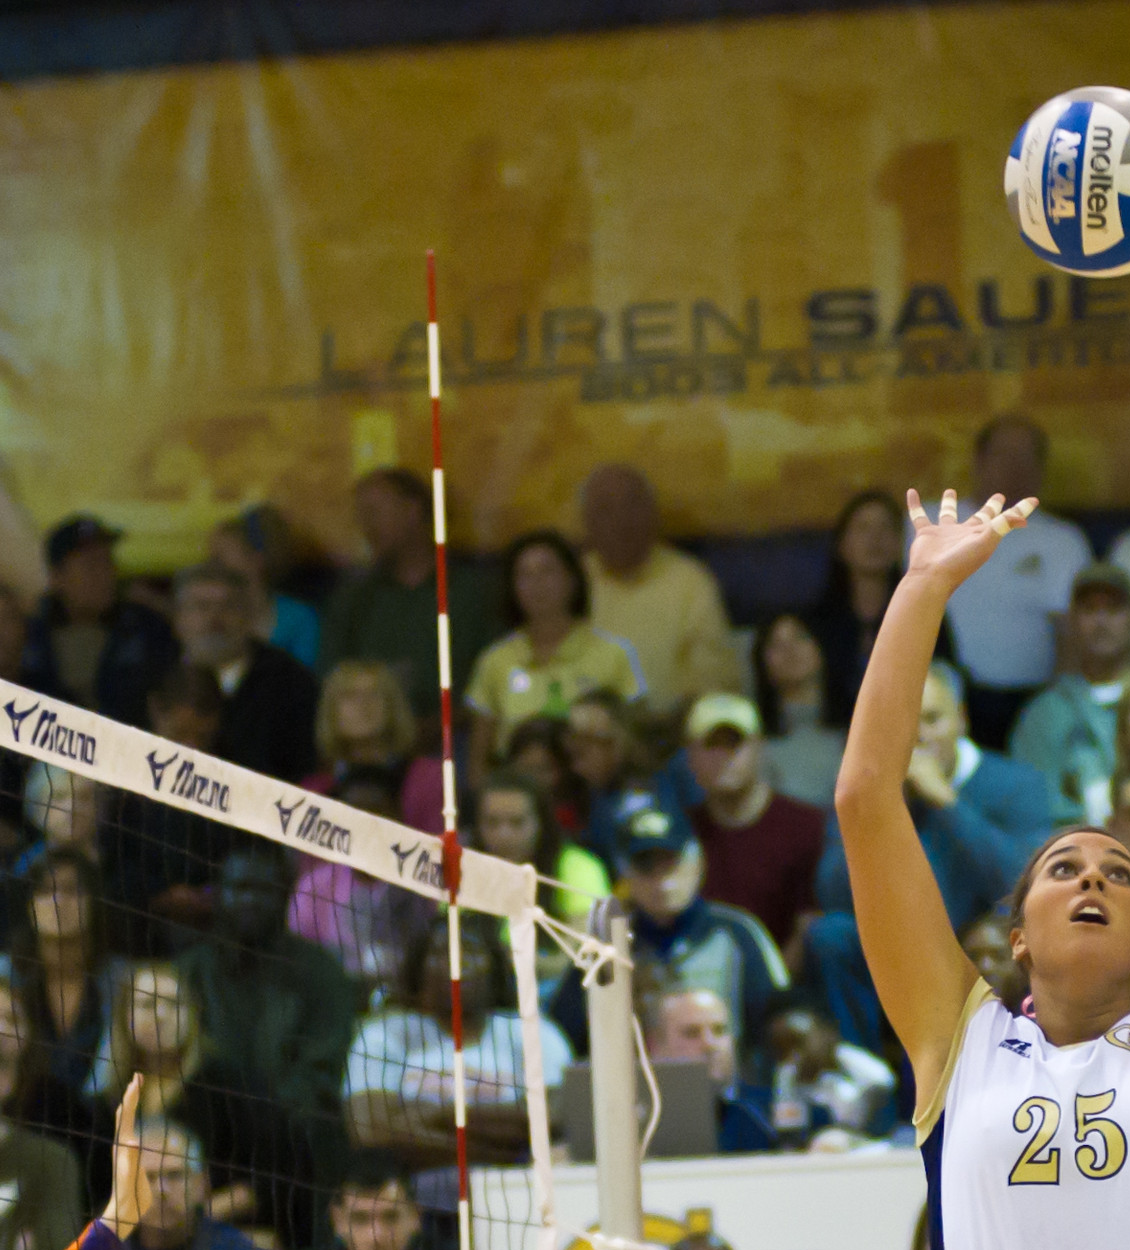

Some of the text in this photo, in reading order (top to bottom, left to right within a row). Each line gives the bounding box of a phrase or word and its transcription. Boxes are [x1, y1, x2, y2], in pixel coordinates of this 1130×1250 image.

[1050, 127, 1082, 222] NCAA
[1085, 125, 1114, 231] molten
[320, 296, 762, 392] LAUREN
[1008, 1088, 1128, 1186] 25
